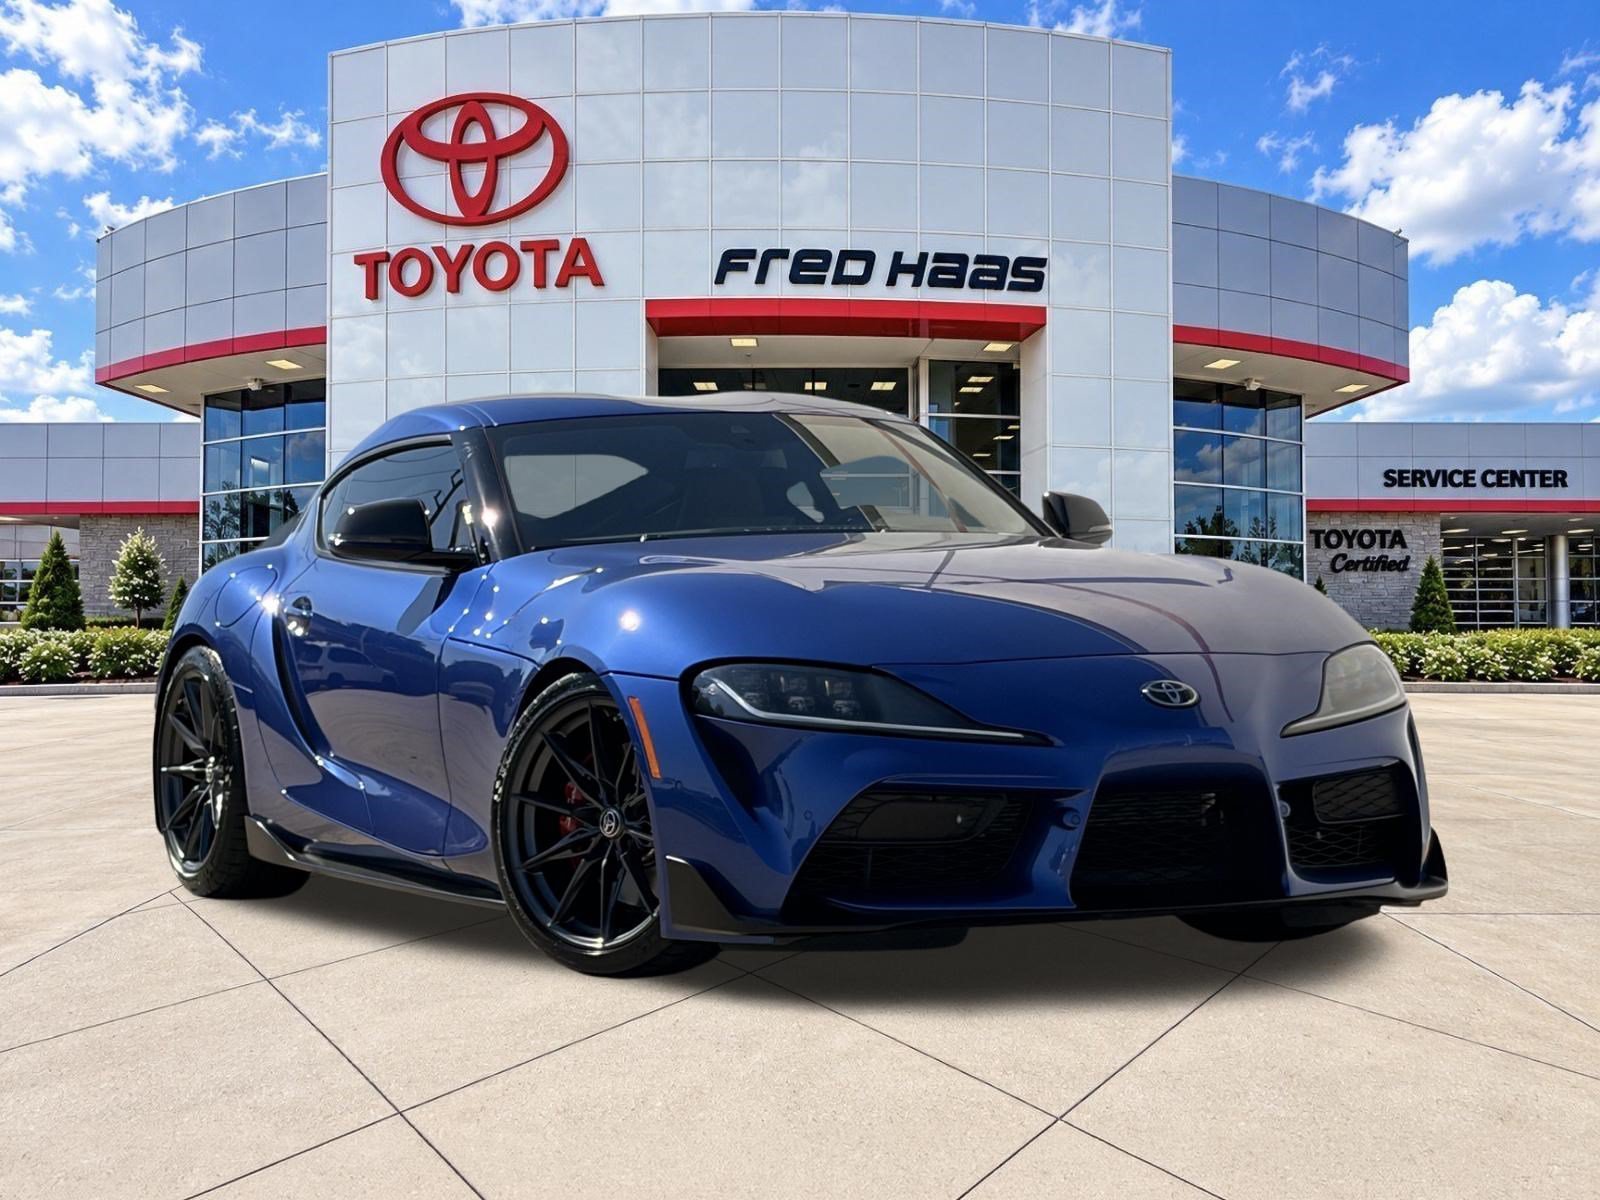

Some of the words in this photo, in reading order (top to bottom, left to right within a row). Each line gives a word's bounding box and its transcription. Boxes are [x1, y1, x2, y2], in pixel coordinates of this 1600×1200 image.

[354, 238, 605, 300] TOYOTA
[886, 251, 1048, 292] Haas
[1383, 468, 1477, 488] SERVICE
[1481, 469, 1568, 488] CENTER
[1309, 529, 1408, 549] TOYOTA
[1330, 553, 1411, 573] Certified
